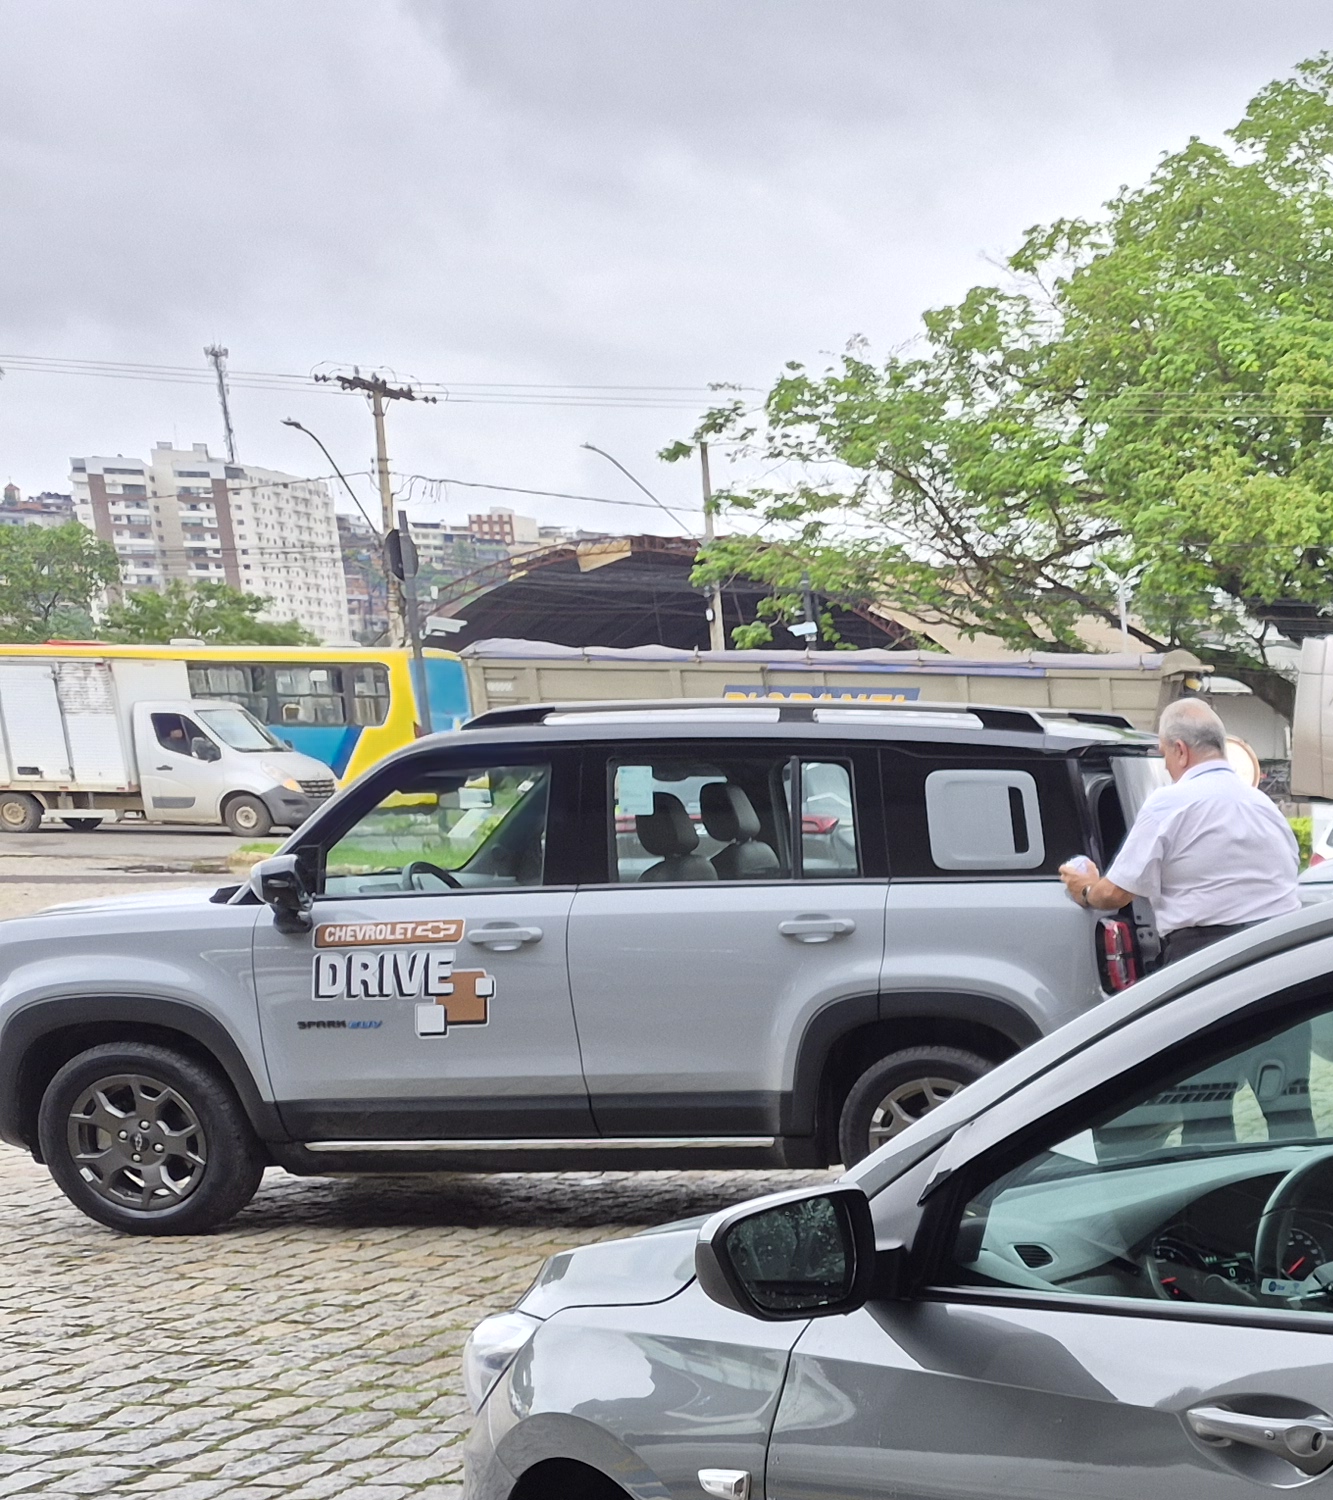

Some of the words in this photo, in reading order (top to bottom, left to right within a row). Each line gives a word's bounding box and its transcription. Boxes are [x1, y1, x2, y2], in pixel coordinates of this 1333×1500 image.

[324, 922, 416, 943] CHEVROLET
[314, 950, 456, 1000] DRIVE
[297, 1020, 347, 1030] SPARK
